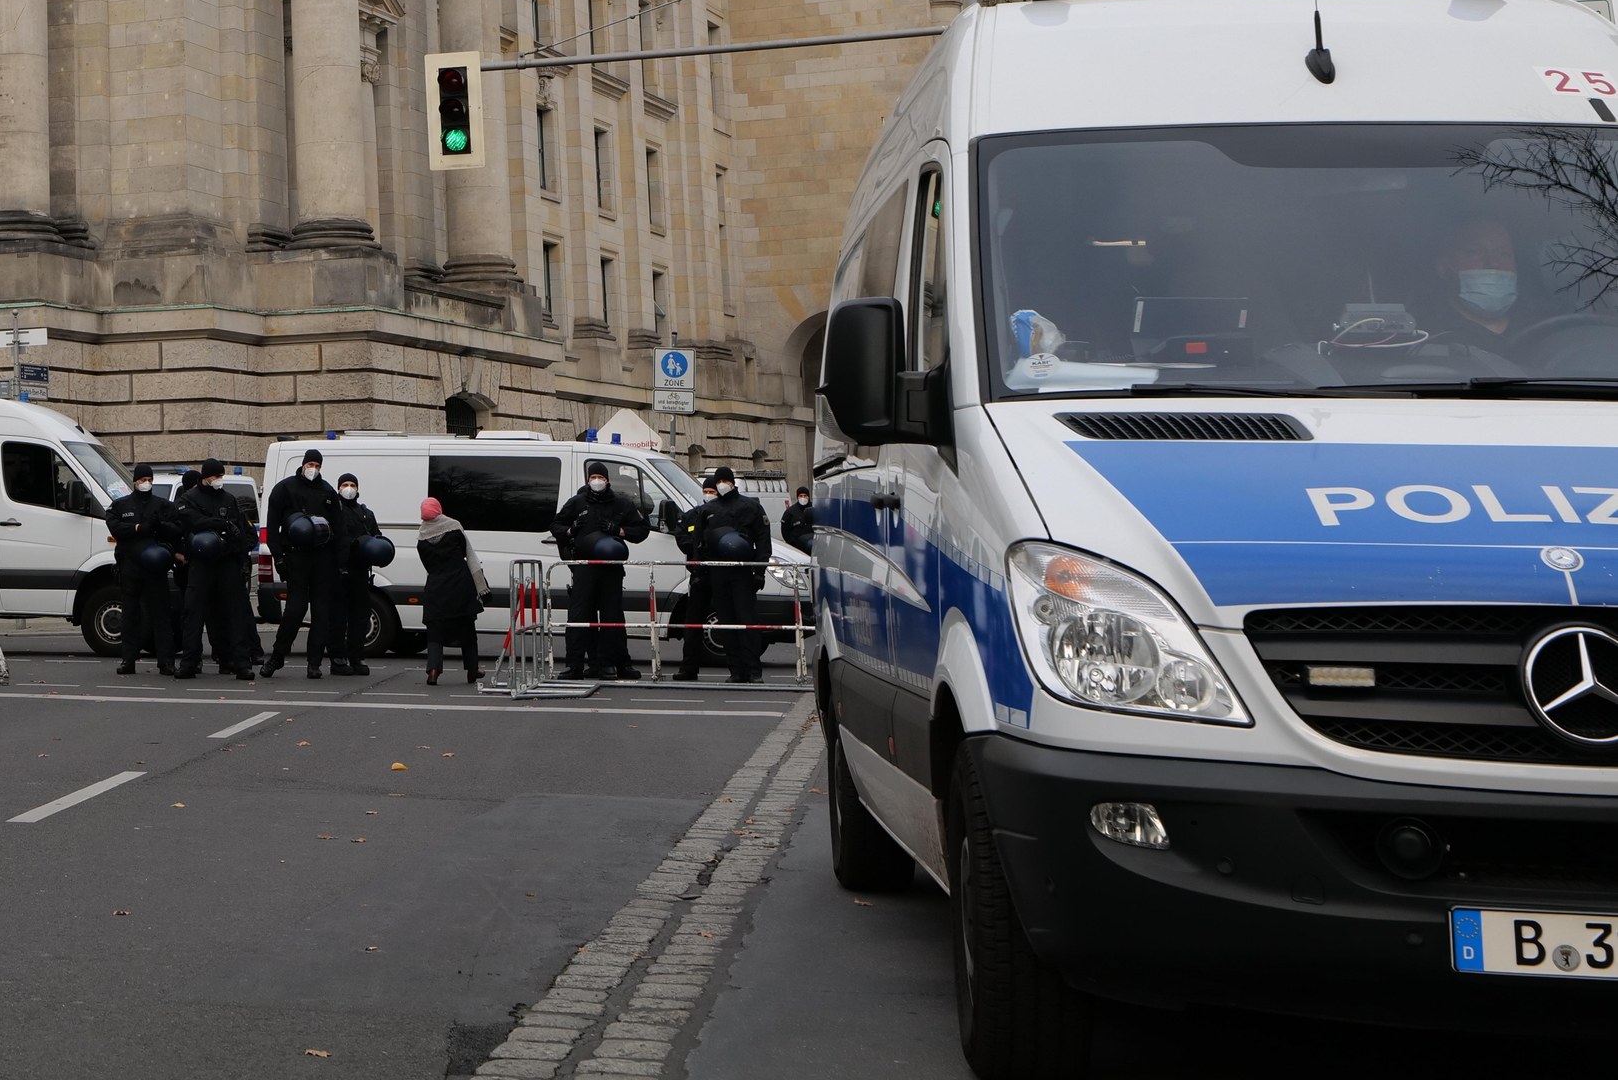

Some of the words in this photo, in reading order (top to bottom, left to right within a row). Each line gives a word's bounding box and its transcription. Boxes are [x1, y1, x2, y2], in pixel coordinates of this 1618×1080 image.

[1544, 69, 1617, 95] 25
[664, 379, 685, 387] ZONE
[1305, 484, 1618, 527] POLIZ
[1463, 946, 1474, 959] D
[1514, 919, 1546, 966] B
